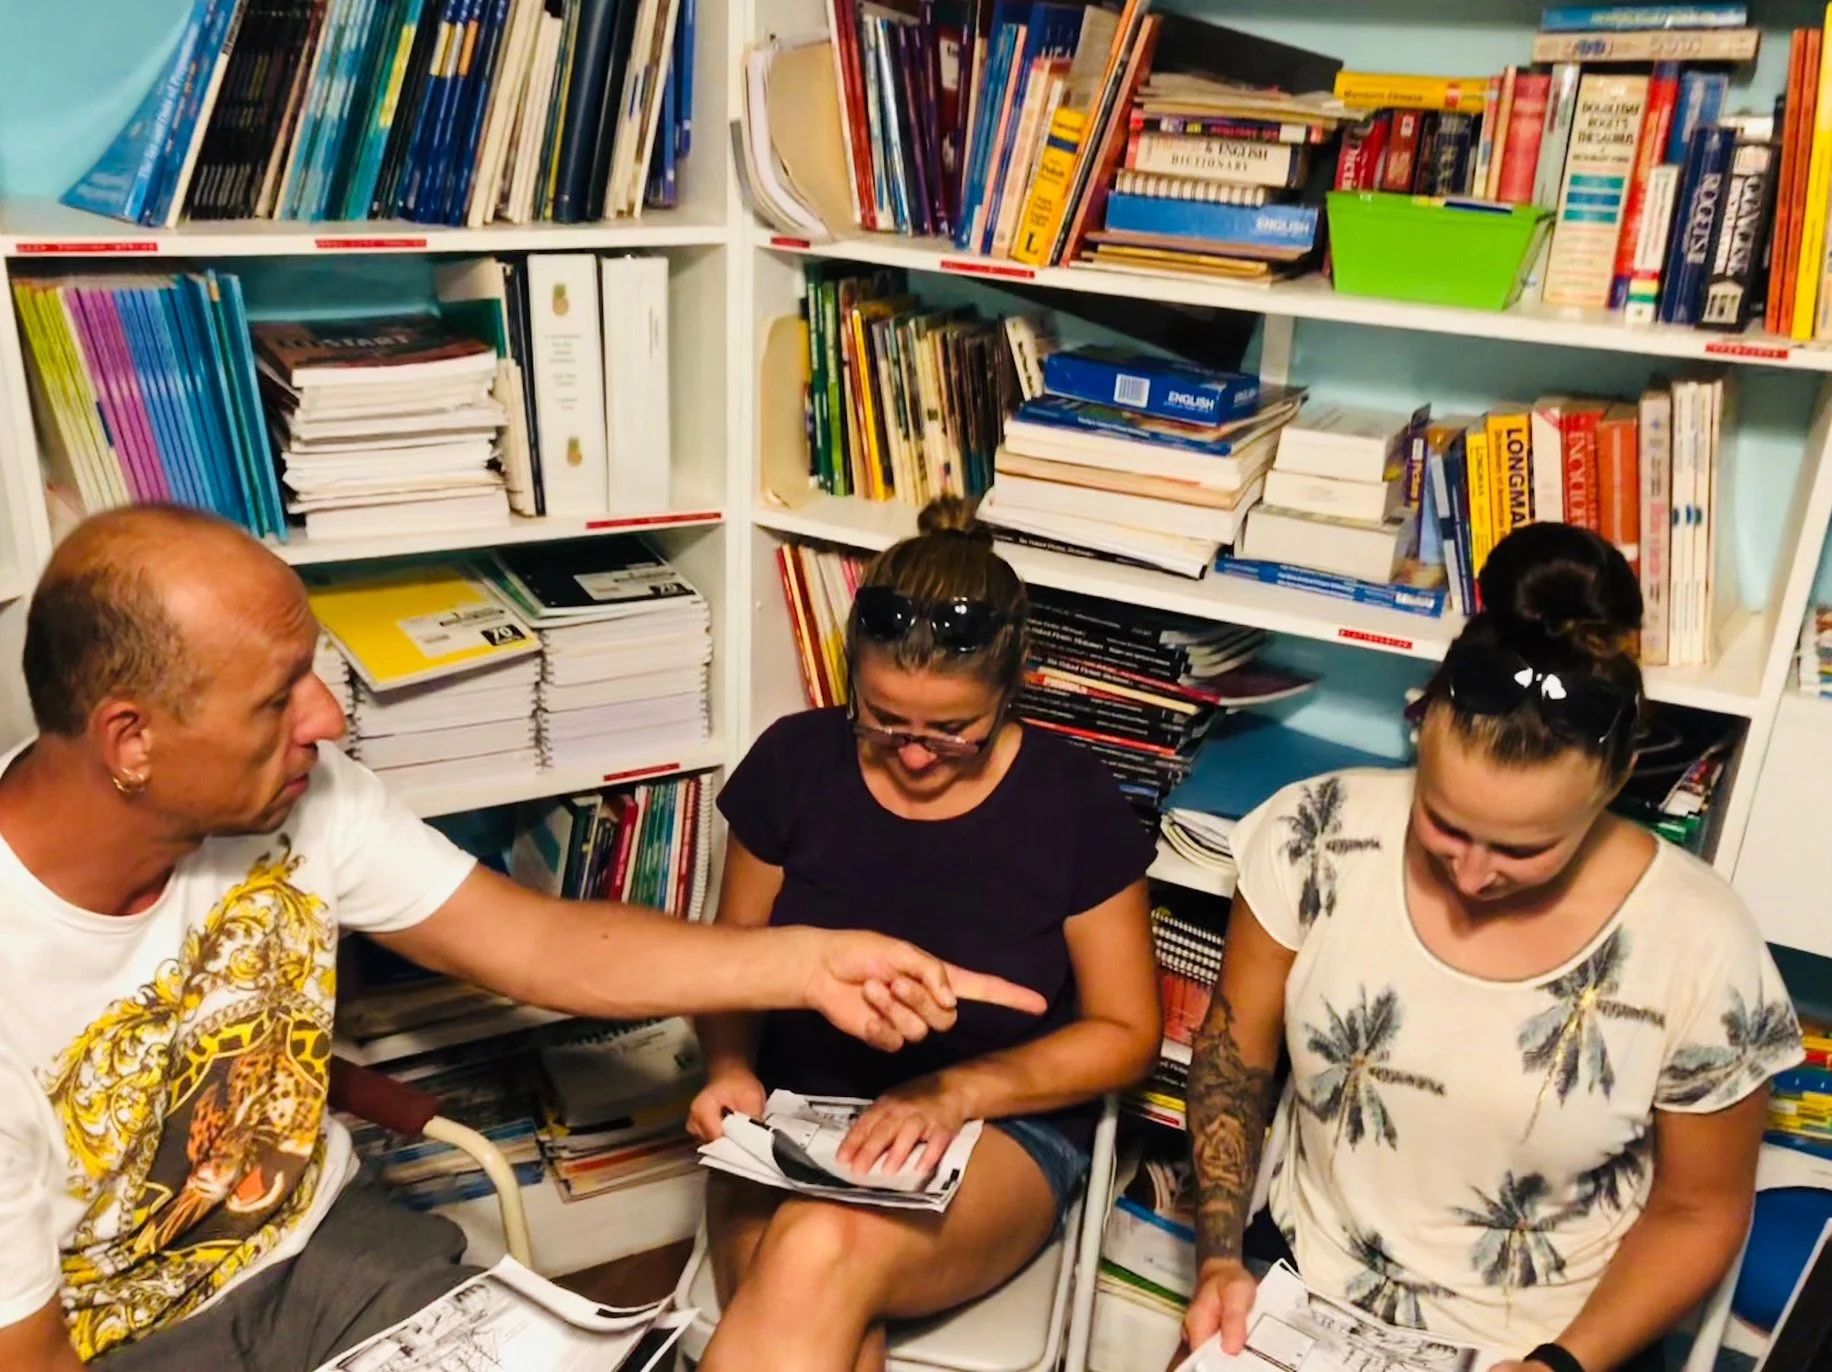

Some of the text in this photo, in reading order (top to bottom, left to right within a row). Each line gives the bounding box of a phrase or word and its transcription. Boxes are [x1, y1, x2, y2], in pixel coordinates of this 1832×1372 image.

[1218, 142, 1269, 161] ENGLISH
[1171, 155, 1250, 173] DICTIONARY
[1256, 215, 1310, 235] ENGLISH
[1168, 391, 1215, 411] ENGLISH
[1506, 429, 1526, 526] LONGMA
